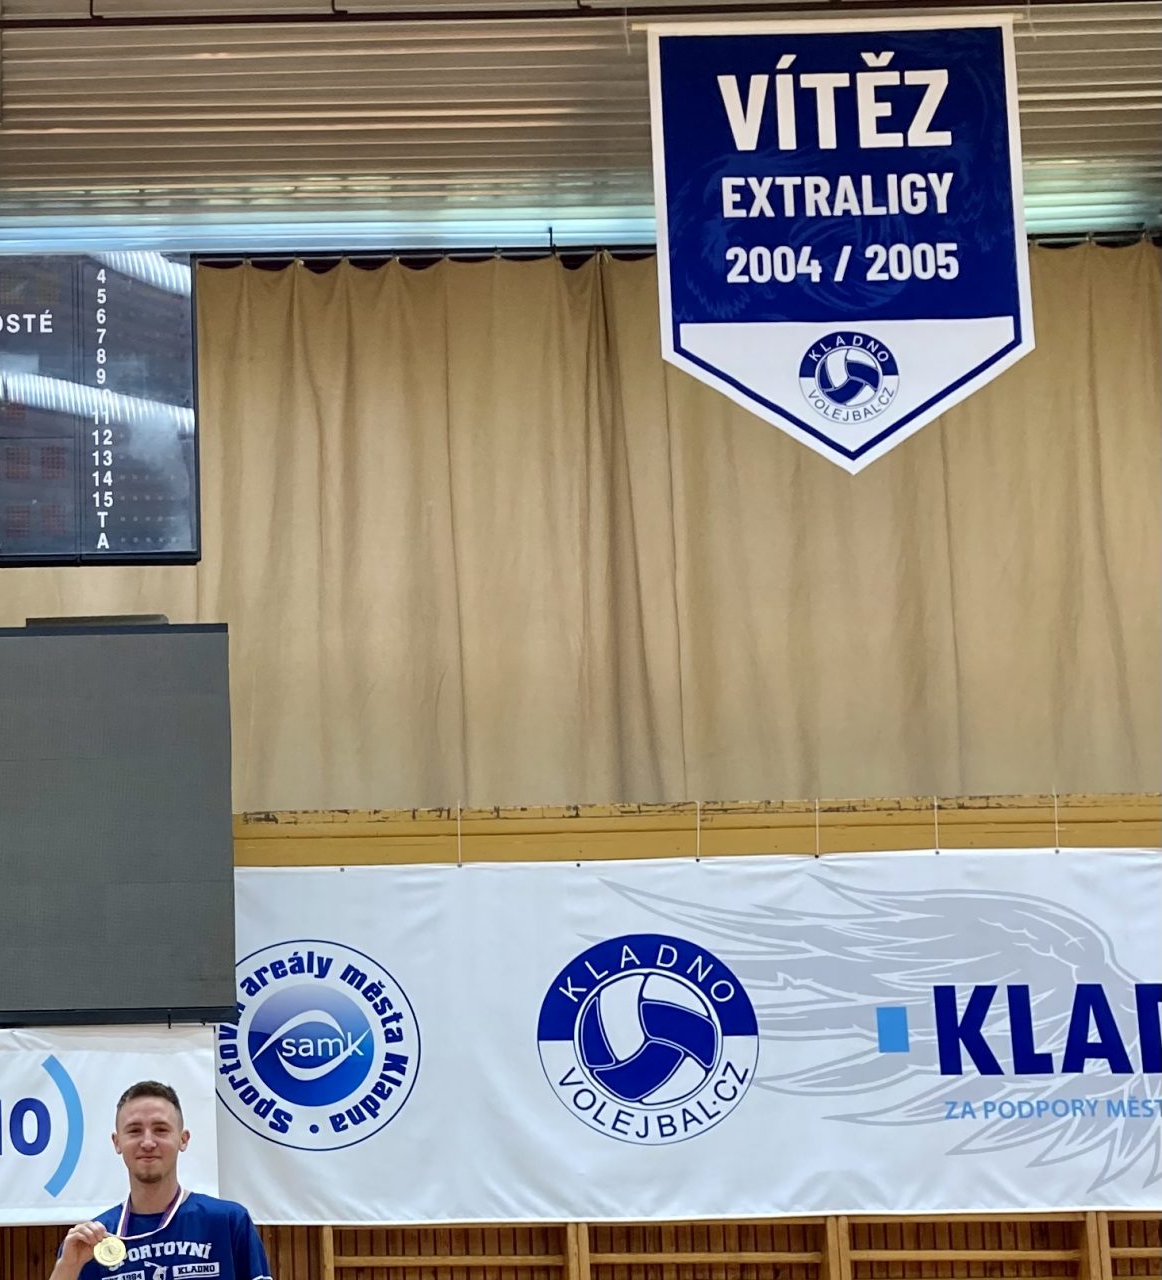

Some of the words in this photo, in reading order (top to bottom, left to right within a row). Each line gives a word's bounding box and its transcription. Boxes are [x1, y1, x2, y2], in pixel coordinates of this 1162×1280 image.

[717, 51, 952, 151] VÍTĚZ
[721, 172, 954, 218] EXTRALIGY
[725, 245, 822, 283] 2004
[833, 245, 852, 282] /
[864, 243, 959, 281] 2005
[96, 268, 106, 284] 4
[96, 288, 107, 304] 5
[96, 308, 107, 324] 6
[96, 328, 107, 344] 7
[96, 348, 107, 364] 8
[808, 335, 889, 362] KLADNO
[96, 368, 106, 385] 9
[92, 429, 113, 446] 12
[92, 450, 113, 466] 13
[92, 470, 113, 487] 14
[92, 491, 114, 507] 15
[97, 511, 109, 528] T
[96, 532, 110, 549] A
[240, 951, 334, 997] areály
[559, 944, 734, 1003] KLADNO
[339, 963, 404, 1044] města
[281, 1032, 365, 1057] samk
[218, 1001, 293, 1134] Sportov
[329, 1052, 409, 1133] Kladna
[944, 1101, 976, 1120] ZA
[983, 1098, 1098, 1119] PODPORY
[109, 1241, 213, 1271] ORTOVNÍ
[178, 1264, 216, 1275] KLADNO
